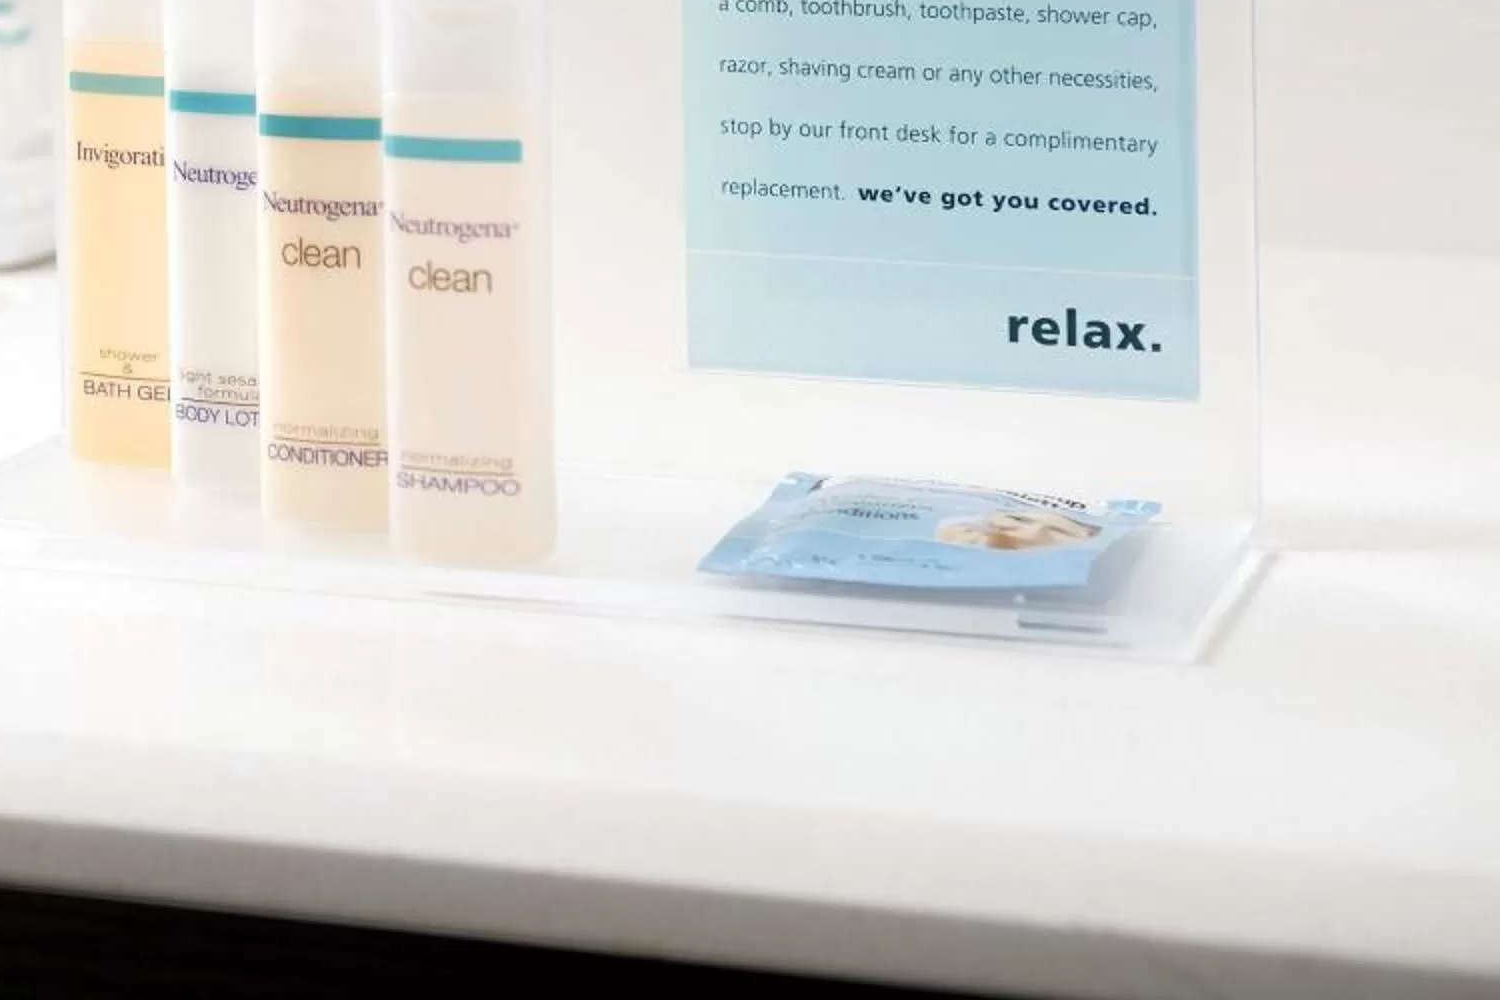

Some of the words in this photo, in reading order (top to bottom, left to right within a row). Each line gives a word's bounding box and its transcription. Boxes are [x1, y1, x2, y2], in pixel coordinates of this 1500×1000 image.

[918, 1, 1031, 25] toothpaste,
[1036, 4, 1111, 27] shower
[1116, 11, 1158, 32] cap,
[718, 57, 773, 78] razor,
[778, 57, 851, 83] shaving
[856, 64, 916, 82] cream
[921, 66, 943, 82] or
[948, 67, 985, 88] any
[988, 65, 1043, 87] other
[1048, 69, 1159, 94] necessities,
[719, 117, 763, 140] stop
[767, 116, 793, 144] by
[798, 122, 834, 140] our
[839, 119, 890, 142] front
[895, 123, 942, 145] desk
[946, 125, 979, 145] for
[984, 130, 998, 148] a
[1003, 128, 1160, 159] complimentary
[720, 177, 846, 203] replacement.
[857, 185, 933, 207] we’ve
[939, 189, 985, 212] got
[990, 193, 1040, 214] you
[1046, 196, 1158, 218] covered.
[281, 236, 361, 269] clean
[408, 260, 493, 293] clean
[1007, 307, 1162, 353] relax.
[99, 348, 160, 362] shower
[122, 362, 133, 374] &
[83, 379, 132, 400] BATH
[175, 403, 220, 424] BODY
[273, 423, 380, 440] normalizing
[267, 443, 388, 468] CONDITIONER
[401, 451, 514, 471] normalizing
[396, 471, 522, 496] SHAMPOO
